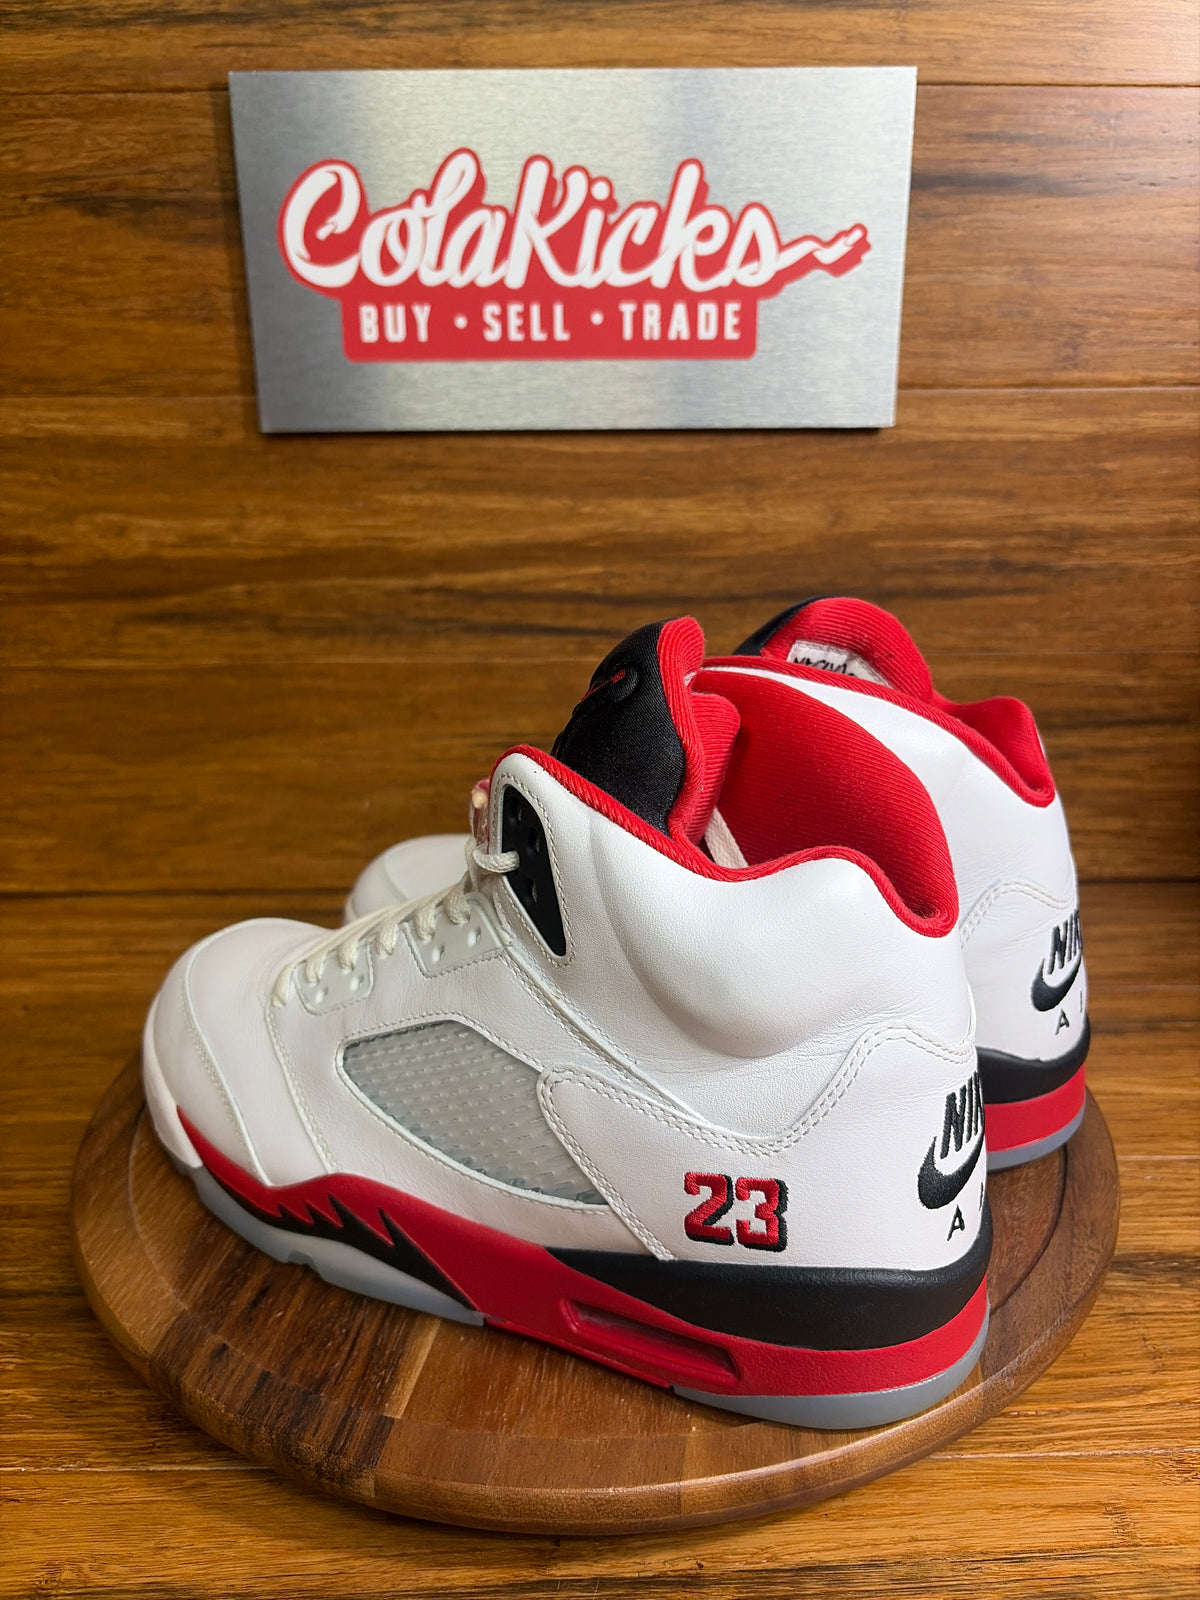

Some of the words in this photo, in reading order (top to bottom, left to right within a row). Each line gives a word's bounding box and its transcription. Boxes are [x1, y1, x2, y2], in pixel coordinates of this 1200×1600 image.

[281, 149, 864, 292] ColaKicks
[359, 304, 432, 344] BUY
[482, 304, 571, 341] SELL
[619, 302, 743, 341] TRADE
[1047, 909, 1082, 975] NIK
[939, 1070, 985, 1160] NIK
[683, 1172, 789, 1252] 23
